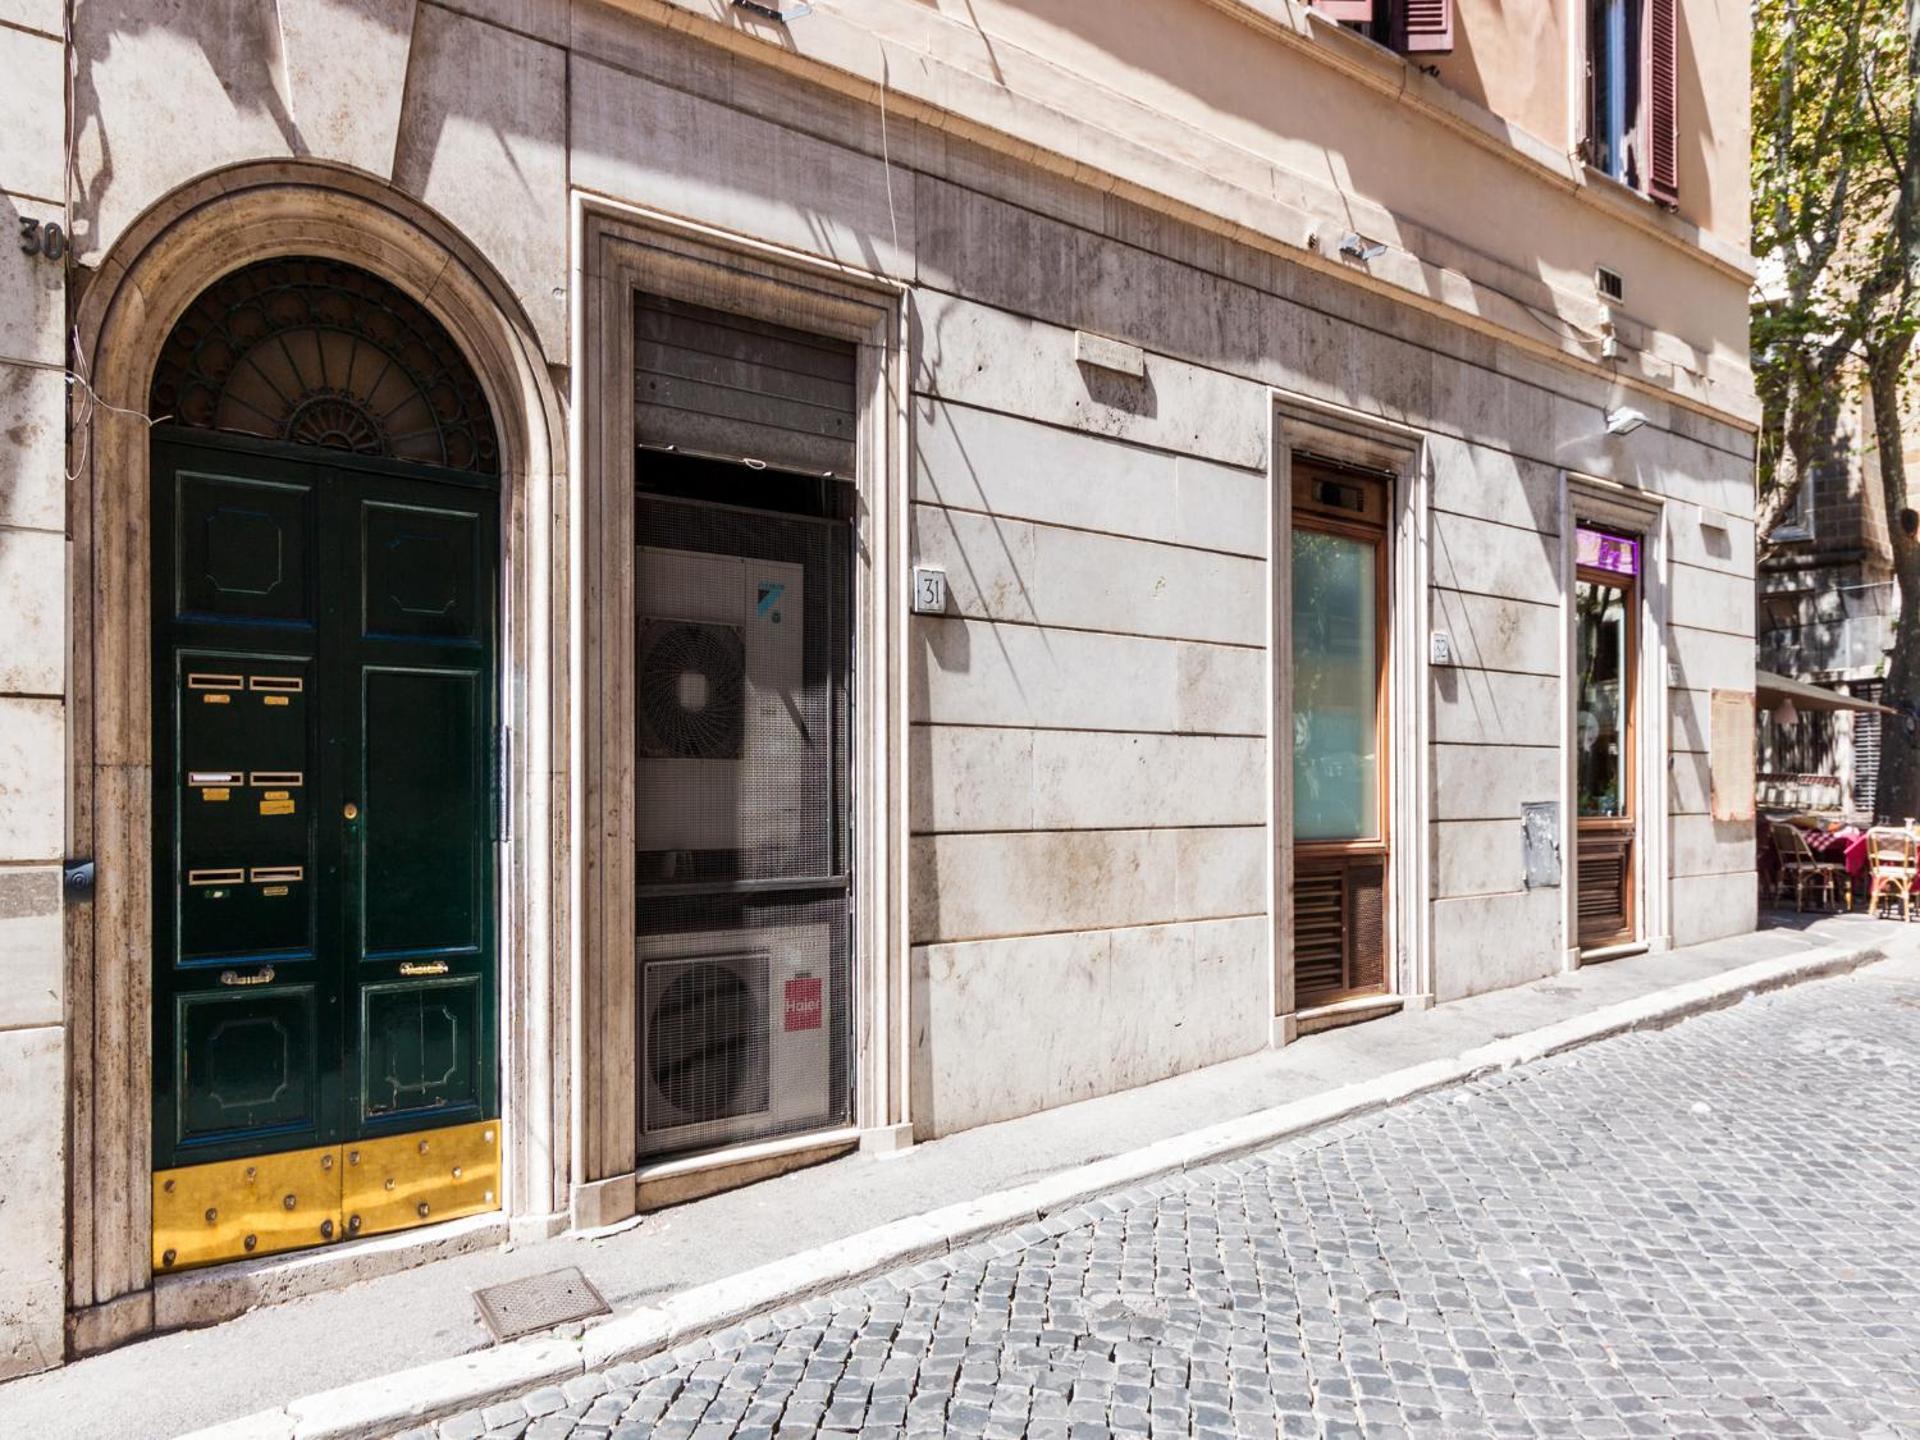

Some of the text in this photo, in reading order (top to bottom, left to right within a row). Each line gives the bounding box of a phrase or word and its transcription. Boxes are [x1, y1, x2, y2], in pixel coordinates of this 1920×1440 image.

[19, 216, 64, 260] 30
[923, 578, 939, 604] 31
[785, 1000, 820, 1013] Haier
